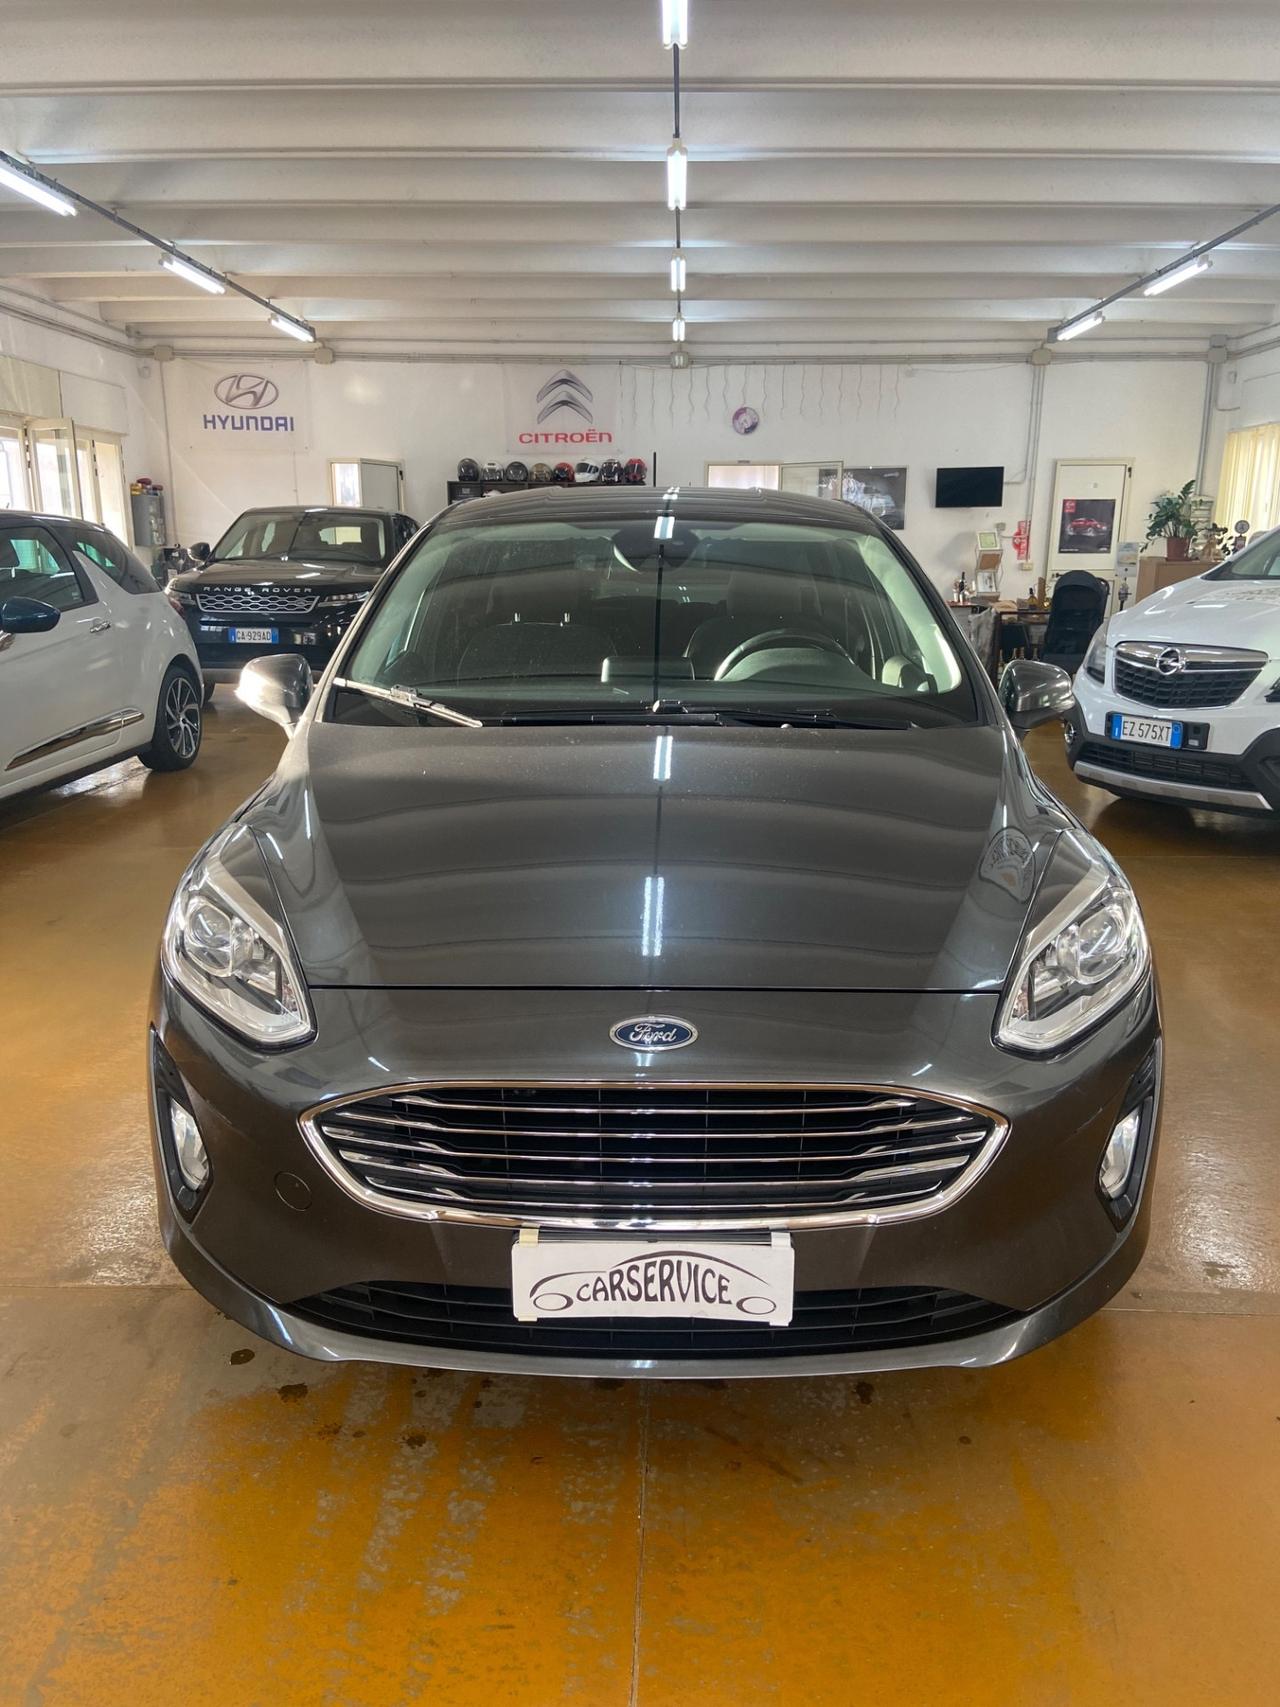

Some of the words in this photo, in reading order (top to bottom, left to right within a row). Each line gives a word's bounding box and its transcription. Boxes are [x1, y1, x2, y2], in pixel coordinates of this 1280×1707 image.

[203, 414, 294, 432] HYUNDAI
[1122, 720, 1136, 737] EZ
[1137, 722, 1171, 742] 575XT
[629, 1022, 677, 1042] Ford
[576, 1259, 732, 1305] CARSERVICE
